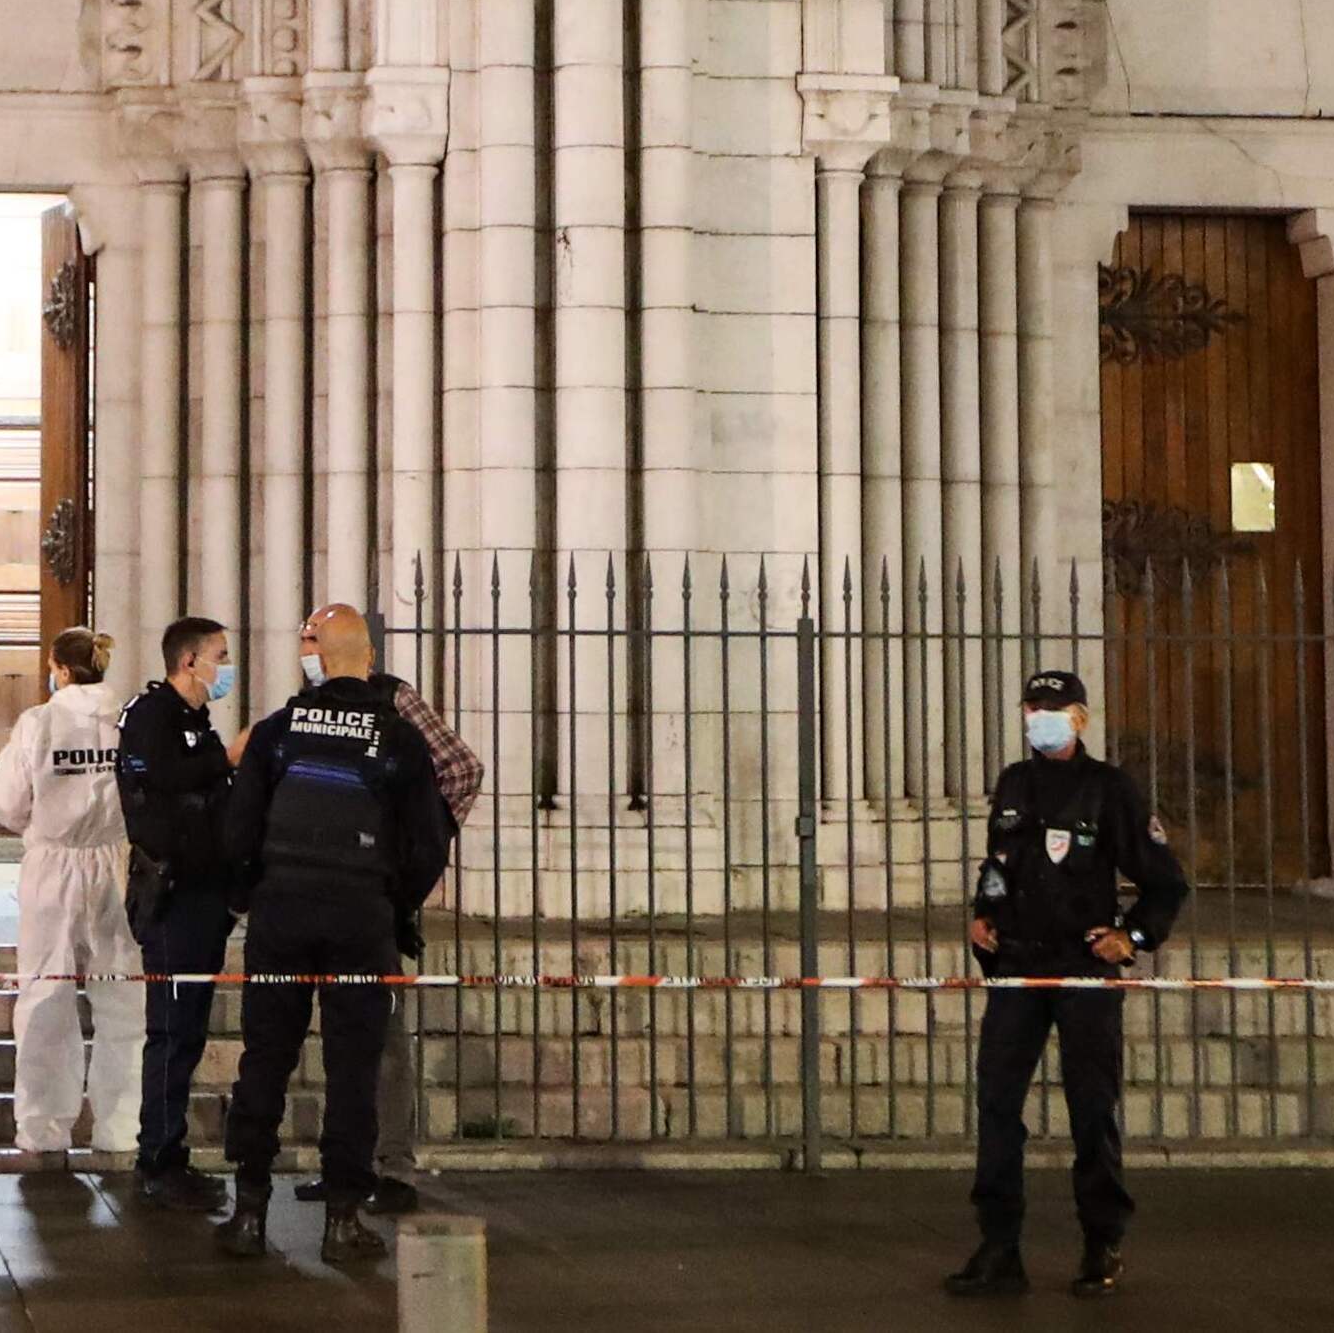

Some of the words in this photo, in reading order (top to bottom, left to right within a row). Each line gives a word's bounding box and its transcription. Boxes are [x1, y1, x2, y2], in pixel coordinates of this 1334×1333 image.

[291, 707, 376, 728] POLICE
[290, 720, 373, 740] MUNICIPALE
[53, 749, 118, 765] POLIC
